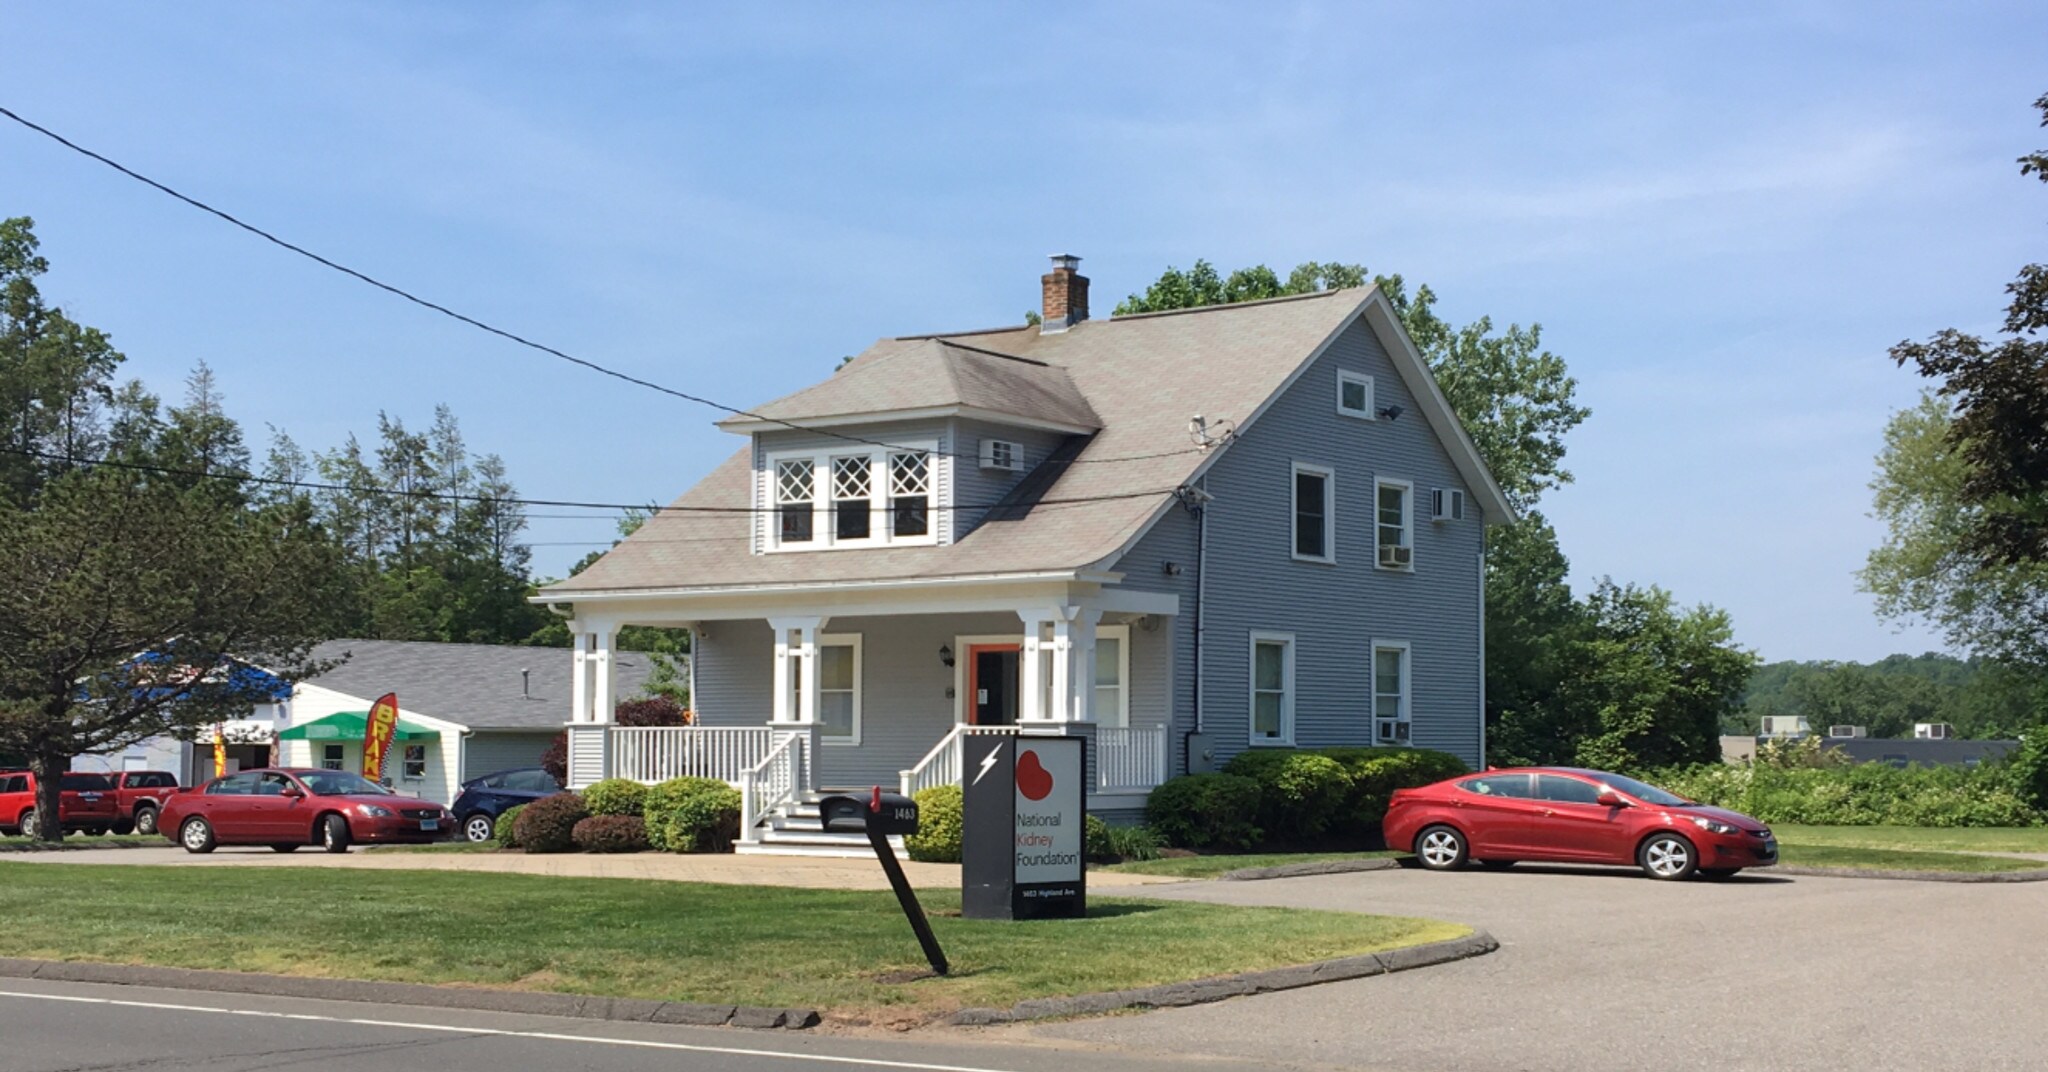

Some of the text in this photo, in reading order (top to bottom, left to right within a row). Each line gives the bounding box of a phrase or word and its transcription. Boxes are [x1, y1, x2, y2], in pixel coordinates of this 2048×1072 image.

[364, 703, 394, 782] BRAK
[895, 807, 915, 820] 1463
[1017, 811, 1062, 827] National
[1017, 832, 1054, 848] Kidney
